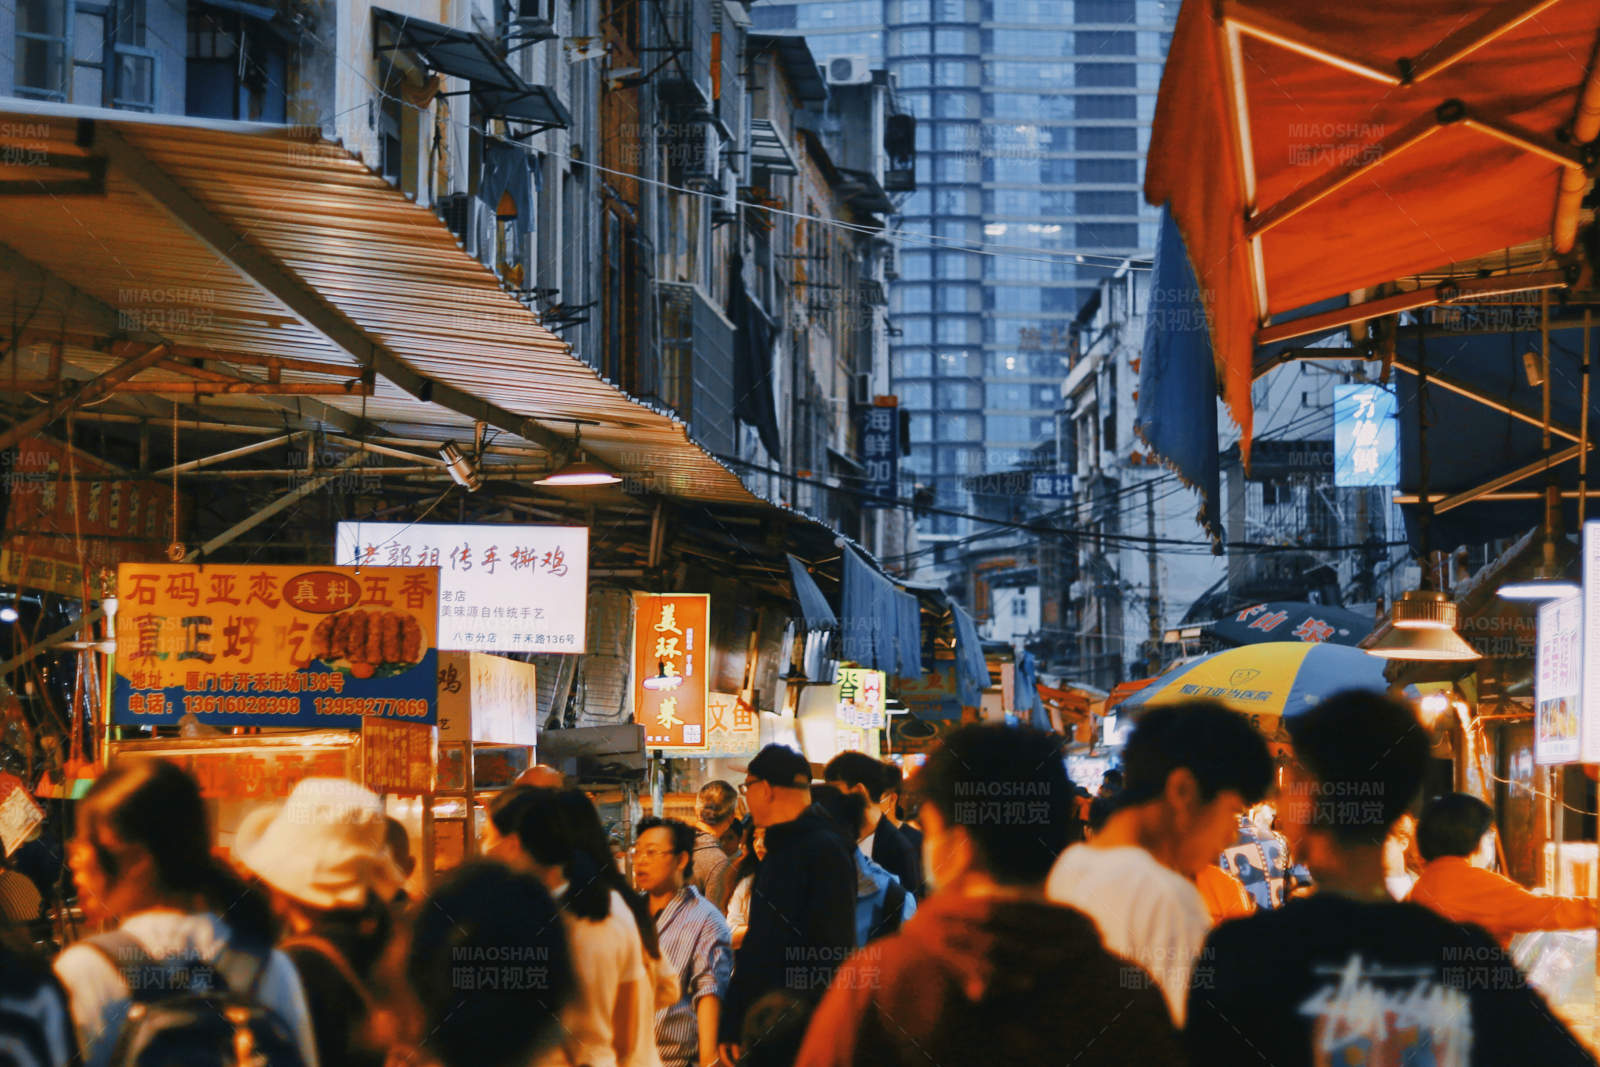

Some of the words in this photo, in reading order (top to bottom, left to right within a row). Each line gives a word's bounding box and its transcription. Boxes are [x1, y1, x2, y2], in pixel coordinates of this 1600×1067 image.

[125, 572, 281, 610] 石码亚恋
[292, 579, 352, 605] 真料
[358, 572, 433, 610] 五香
[441, 590, 466, 602] 老店
[128, 612, 312, 670] 真正好吃
[453, 632, 497, 643] 八市分店
[313, 697, 429, 717] 13959277869
